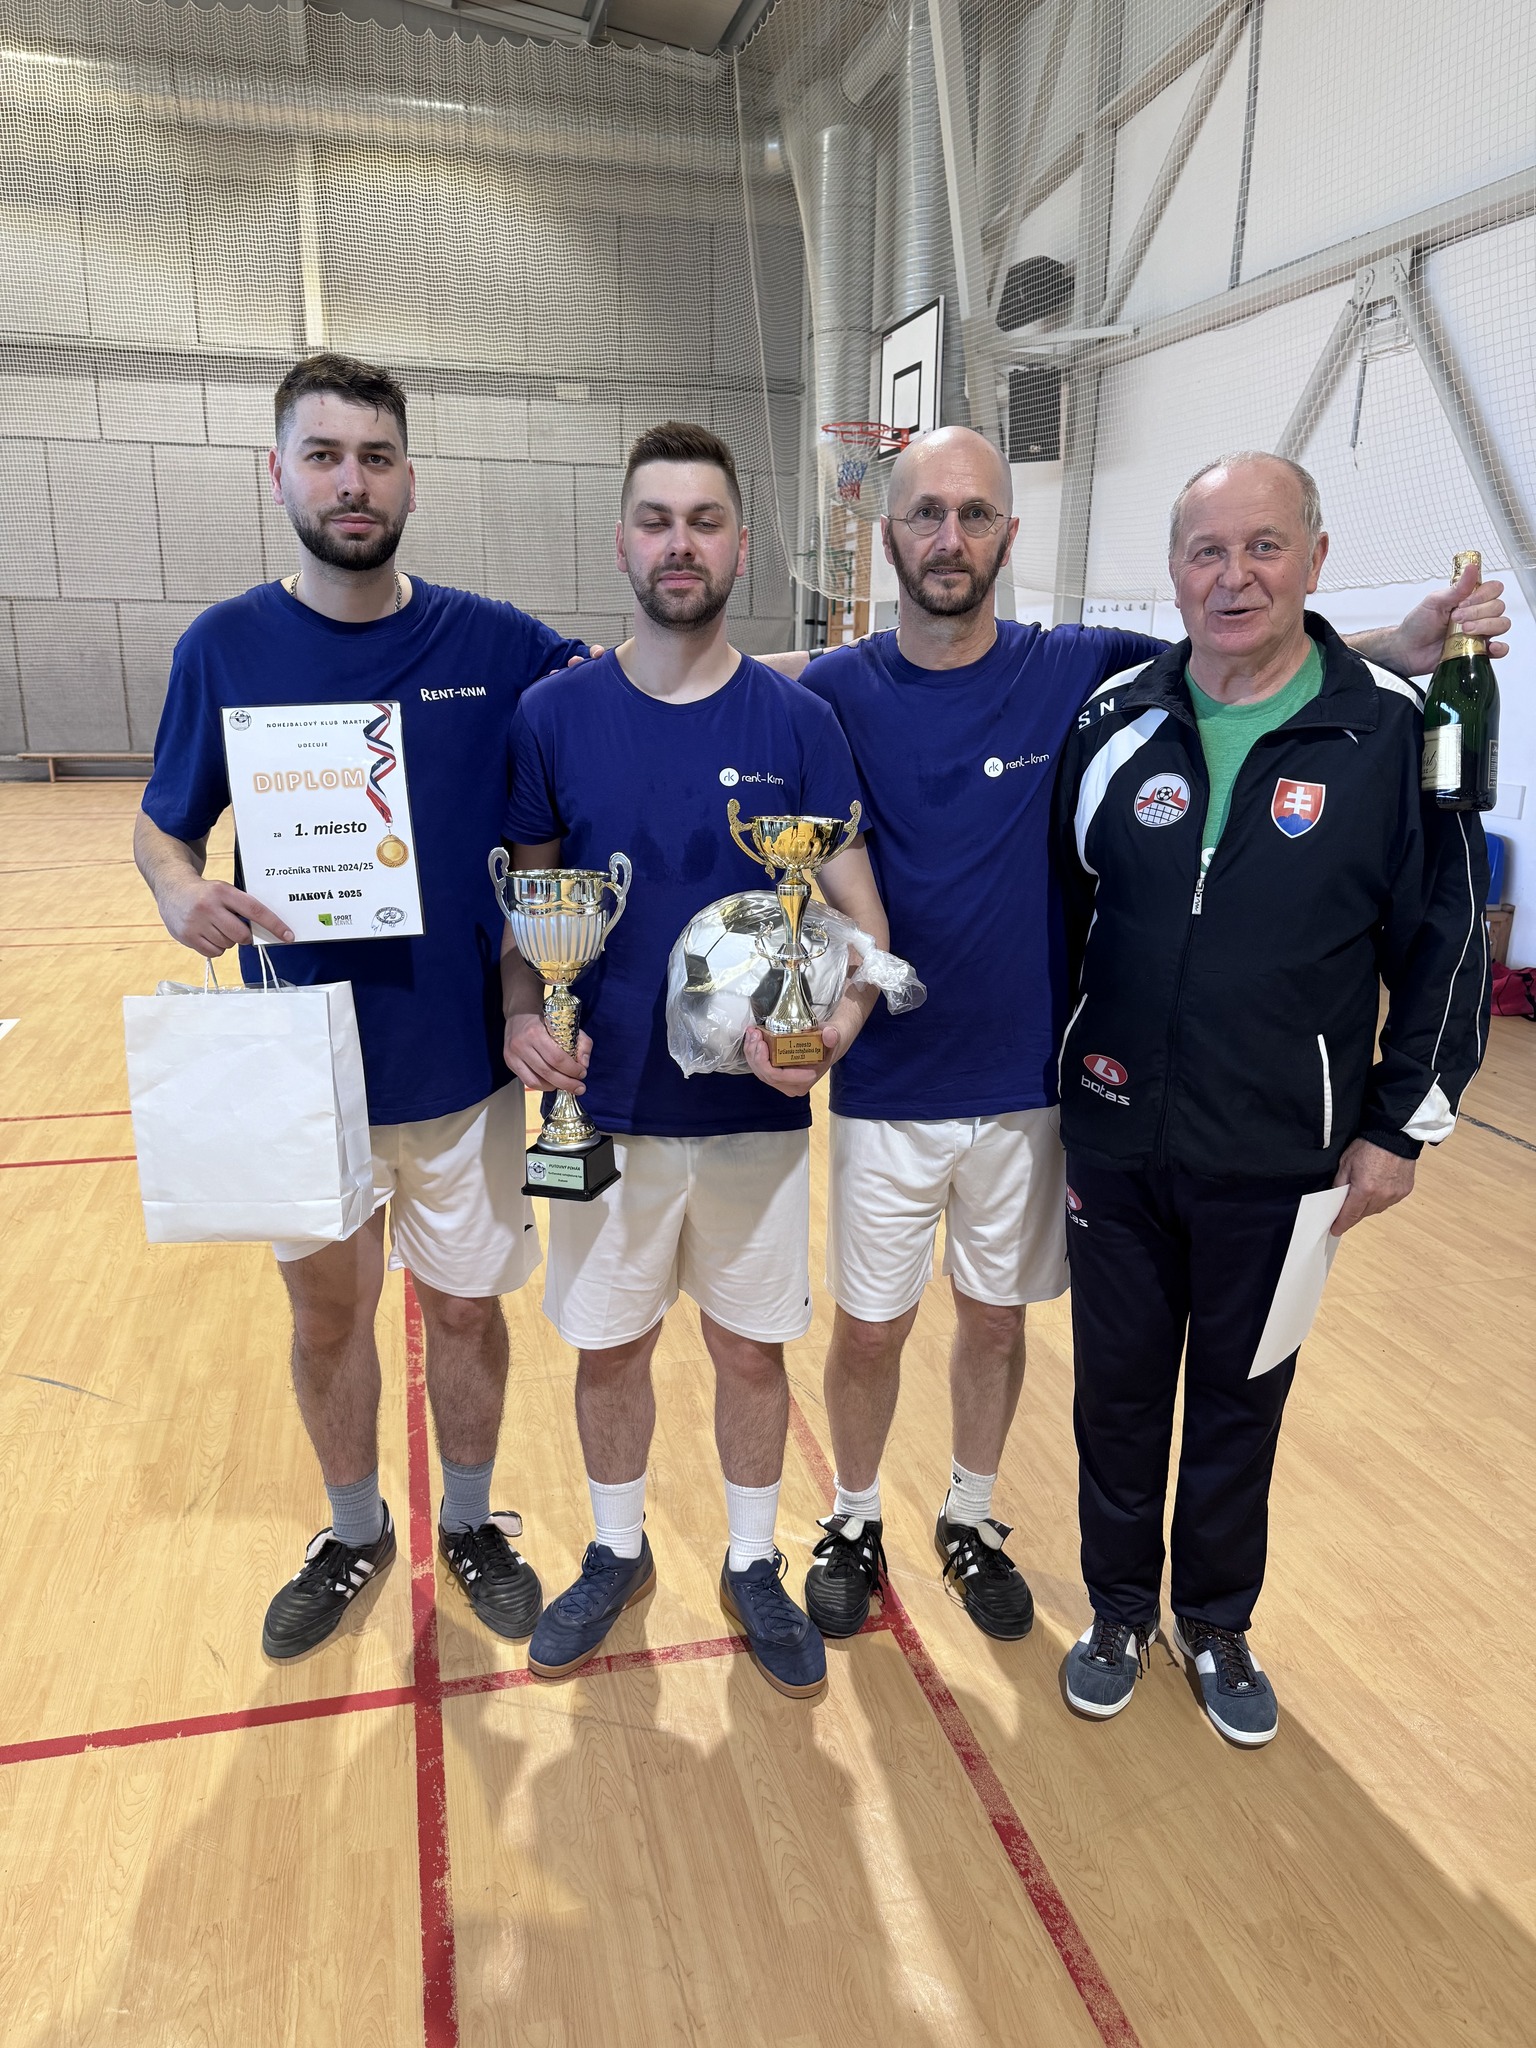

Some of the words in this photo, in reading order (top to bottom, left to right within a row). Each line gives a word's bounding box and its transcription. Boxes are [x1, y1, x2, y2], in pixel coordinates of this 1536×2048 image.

[420, 686, 486, 701] RENT-KNM
[1006, 753, 1049, 769] rent-knm
[254, 769, 364, 792] DIPLOM
[295, 823, 308, 837] 1.
[314, 821, 367, 836] miesto
[265, 866, 311, 876] 27.ročníka
[312, 864, 336, 873] TRNL
[338, 862, 374, 872] 2024/25
[288, 890, 333, 901] DIAKOVÁ
[338, 889, 362, 898] 2025
[1081, 1074, 1130, 1106] botas
[1066, 1204, 1088, 1228] tas
